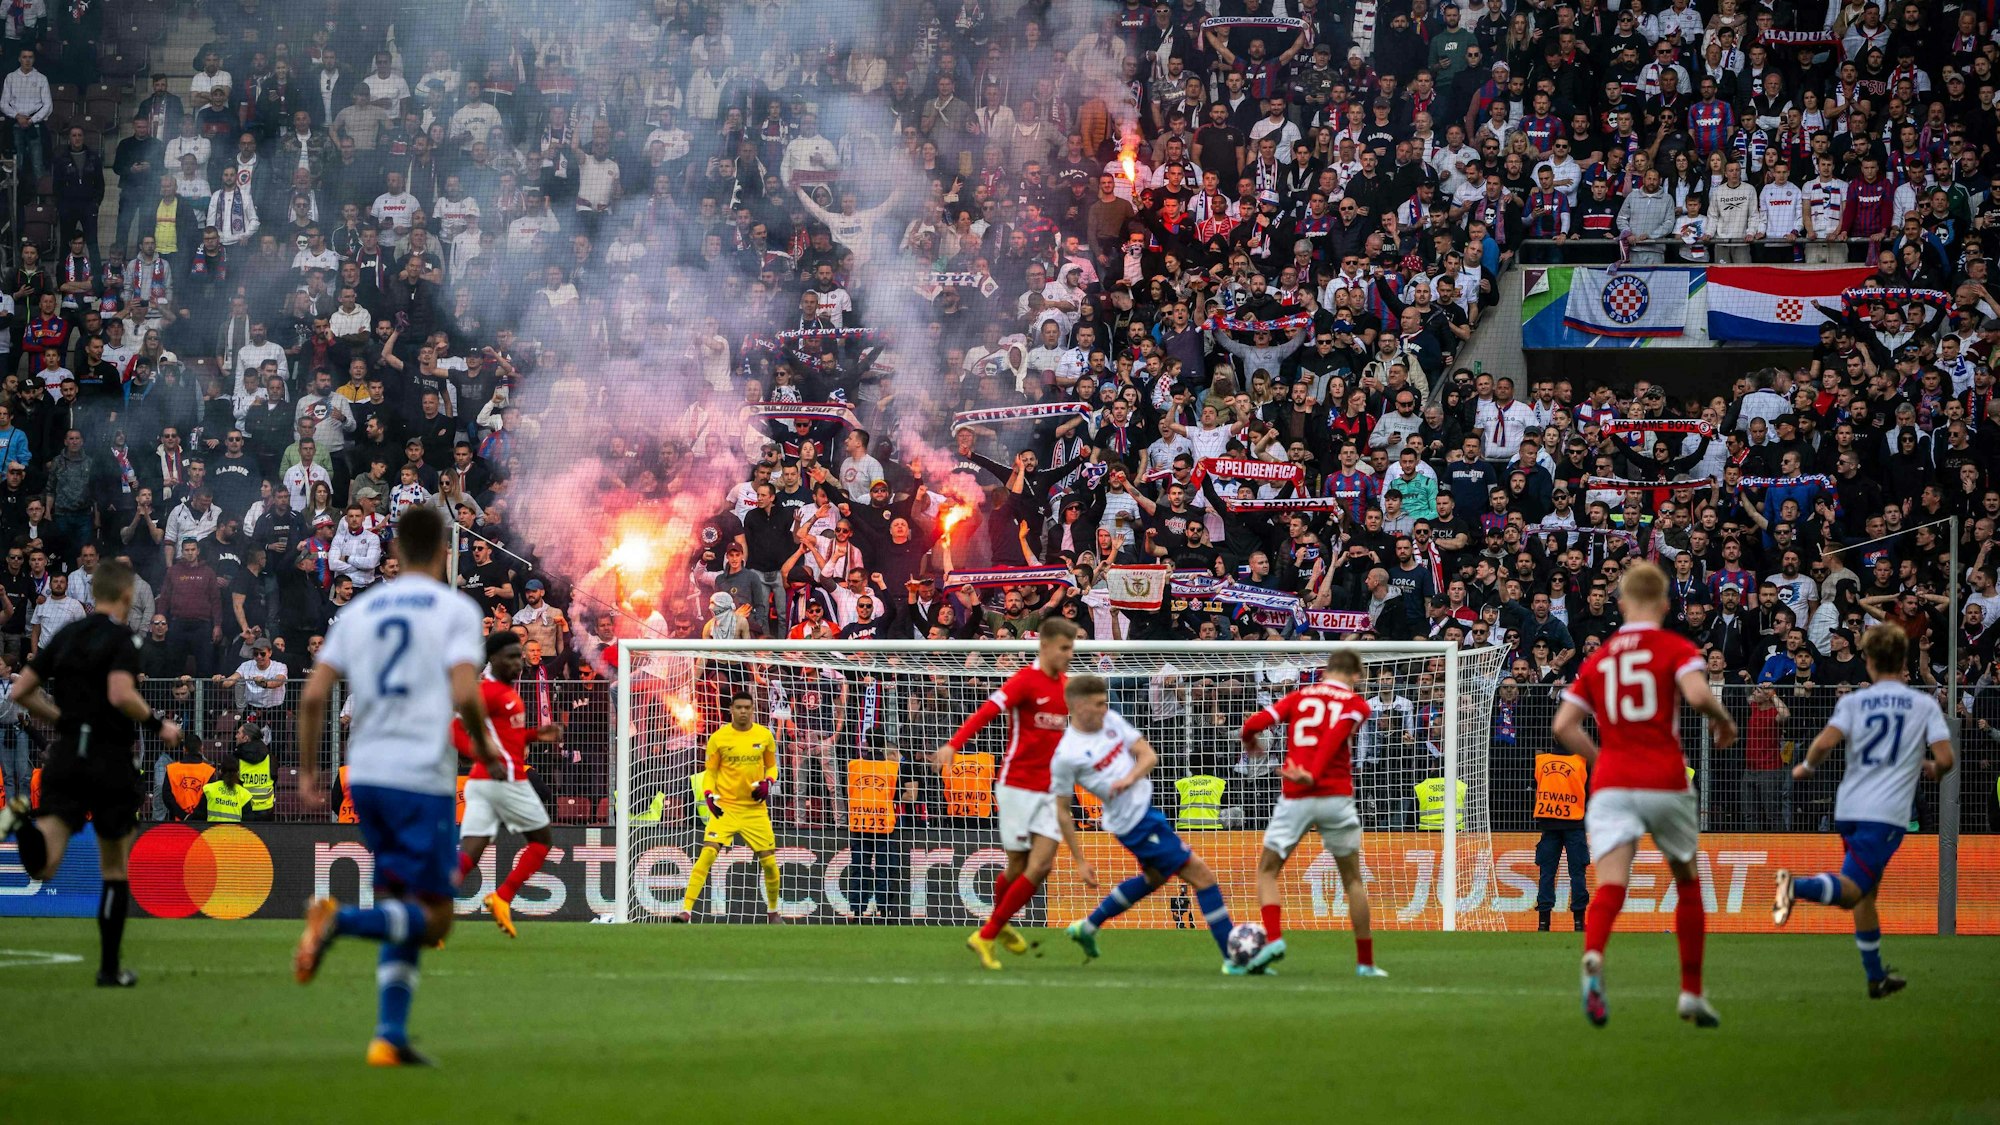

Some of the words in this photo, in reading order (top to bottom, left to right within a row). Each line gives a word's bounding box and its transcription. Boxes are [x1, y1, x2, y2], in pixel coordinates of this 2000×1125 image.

[1763, 29, 1833, 43] HAJDUK
[1697, 118, 1722, 126] TOMMY
[1368, 131, 1395, 143] HAJDUK
[1607, 275, 1647, 294] HAJDUK
[1609, 310, 1640, 324] SPLIT
[764, 405, 803, 414] HAJDUK
[966, 404, 1082, 422] CRIKVENICA
[1668, 420, 1696, 431] BOYS
[215, 465, 249, 477] HAJDUK
[953, 461, 981, 473] AJDUK
[1216, 459, 1297, 478] #PELOBENFICA
[781, 499, 805, 507] AJDUK
[1263, 500, 1330, 511] BENFICA
[1171, 600, 1187, 611] 19
[1204, 601, 1223, 613] 11
[376, 615, 411, 697] 2
[1598, 649, 1658, 724] 15
[1293, 697, 1342, 747] 21
[1861, 713, 1905, 766] 21
[1542, 763, 1574, 778] UEFA
[241, 773, 269, 785] STADIER
[1189, 789, 1212, 797] Stadier
[1539, 792, 1578, 804] TEWARD
[215, 797, 239, 808] Stadier
[1537, 802, 1572, 817] 2463
